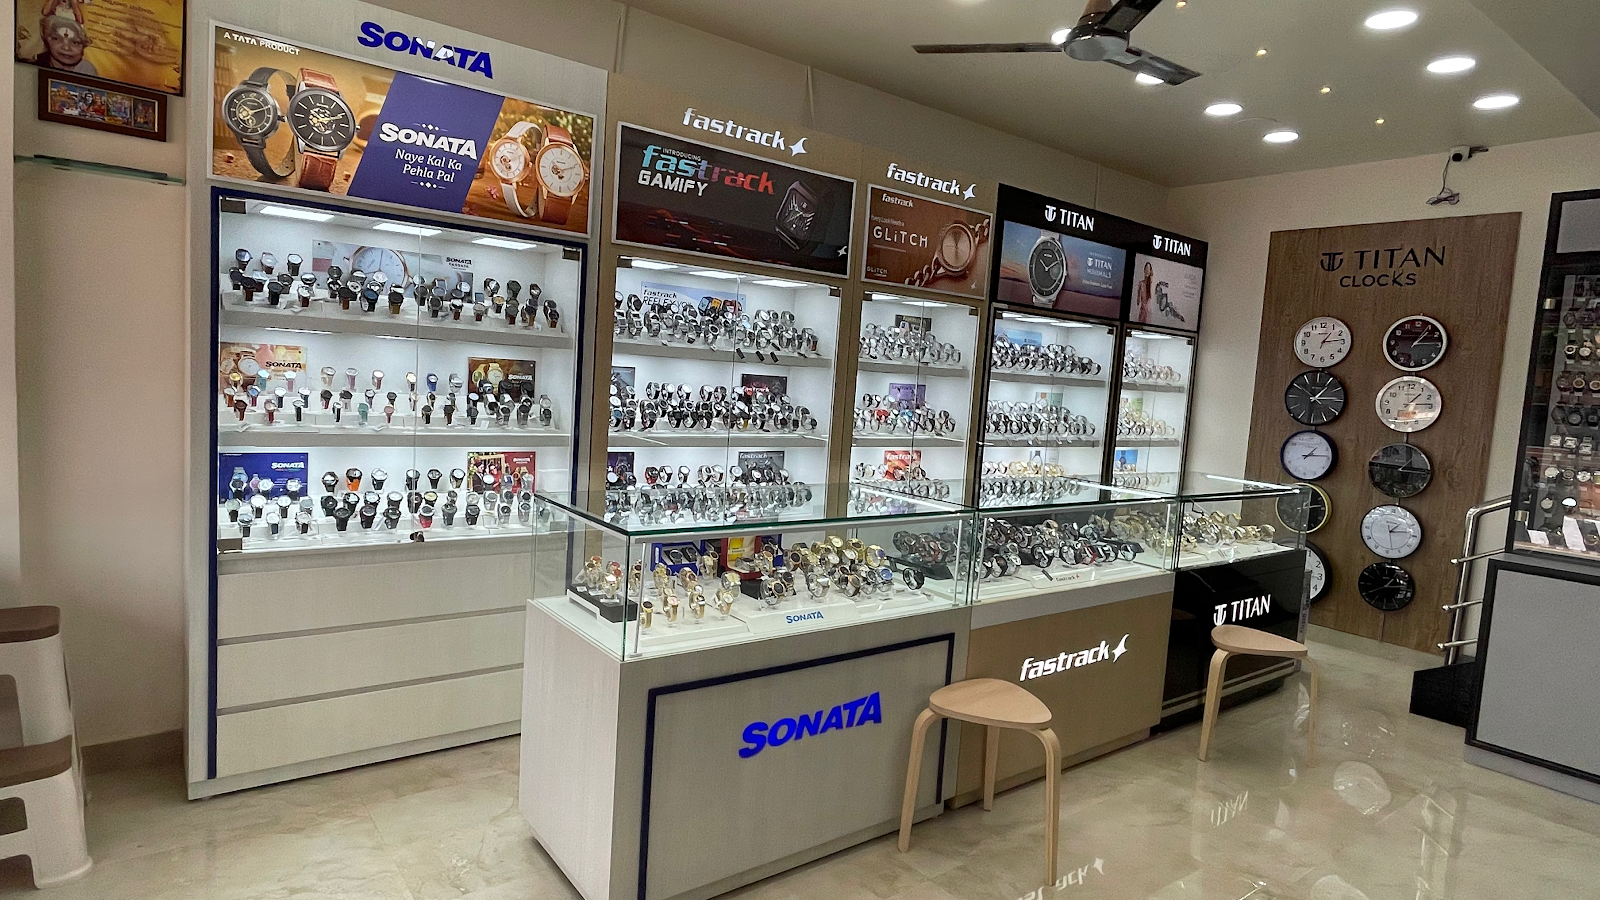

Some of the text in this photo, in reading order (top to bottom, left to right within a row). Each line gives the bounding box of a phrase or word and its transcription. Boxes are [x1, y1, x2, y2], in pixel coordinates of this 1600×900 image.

[223, 31, 300, 56] A TATA PRODUCT
[357, 21, 493, 79] SONATA
[379, 122, 477, 160] SONATA
[682, 107, 786, 151] fastrack
[395, 149, 463, 171] Naye Kal Ka
[662, 148, 702, 161] INTRODUCING
[402, 163, 455, 183] Pehla Pal
[641, 144, 775, 195] fastrack
[886, 162, 960, 196] fastrack
[637, 169, 708, 197] GAMIFY
[881, 193, 914, 208] fastrack
[1059, 208, 1095, 232] TITAN
[1163, 237, 1191, 257] TITAN
[1353, 245, 1446, 270] TITAN
[1094, 258, 1113, 271] TITAN
[1339, 270, 1417, 288] CLOCKS
[265, 361, 302, 369] SONATA
[271, 461, 305, 469] SONATA
[786, 610, 824, 625] SONATA
[1230, 594, 1271, 622] TITAN
[1019, 640, 1110, 682] fastrack
[738, 691, 882, 759] SONATA
